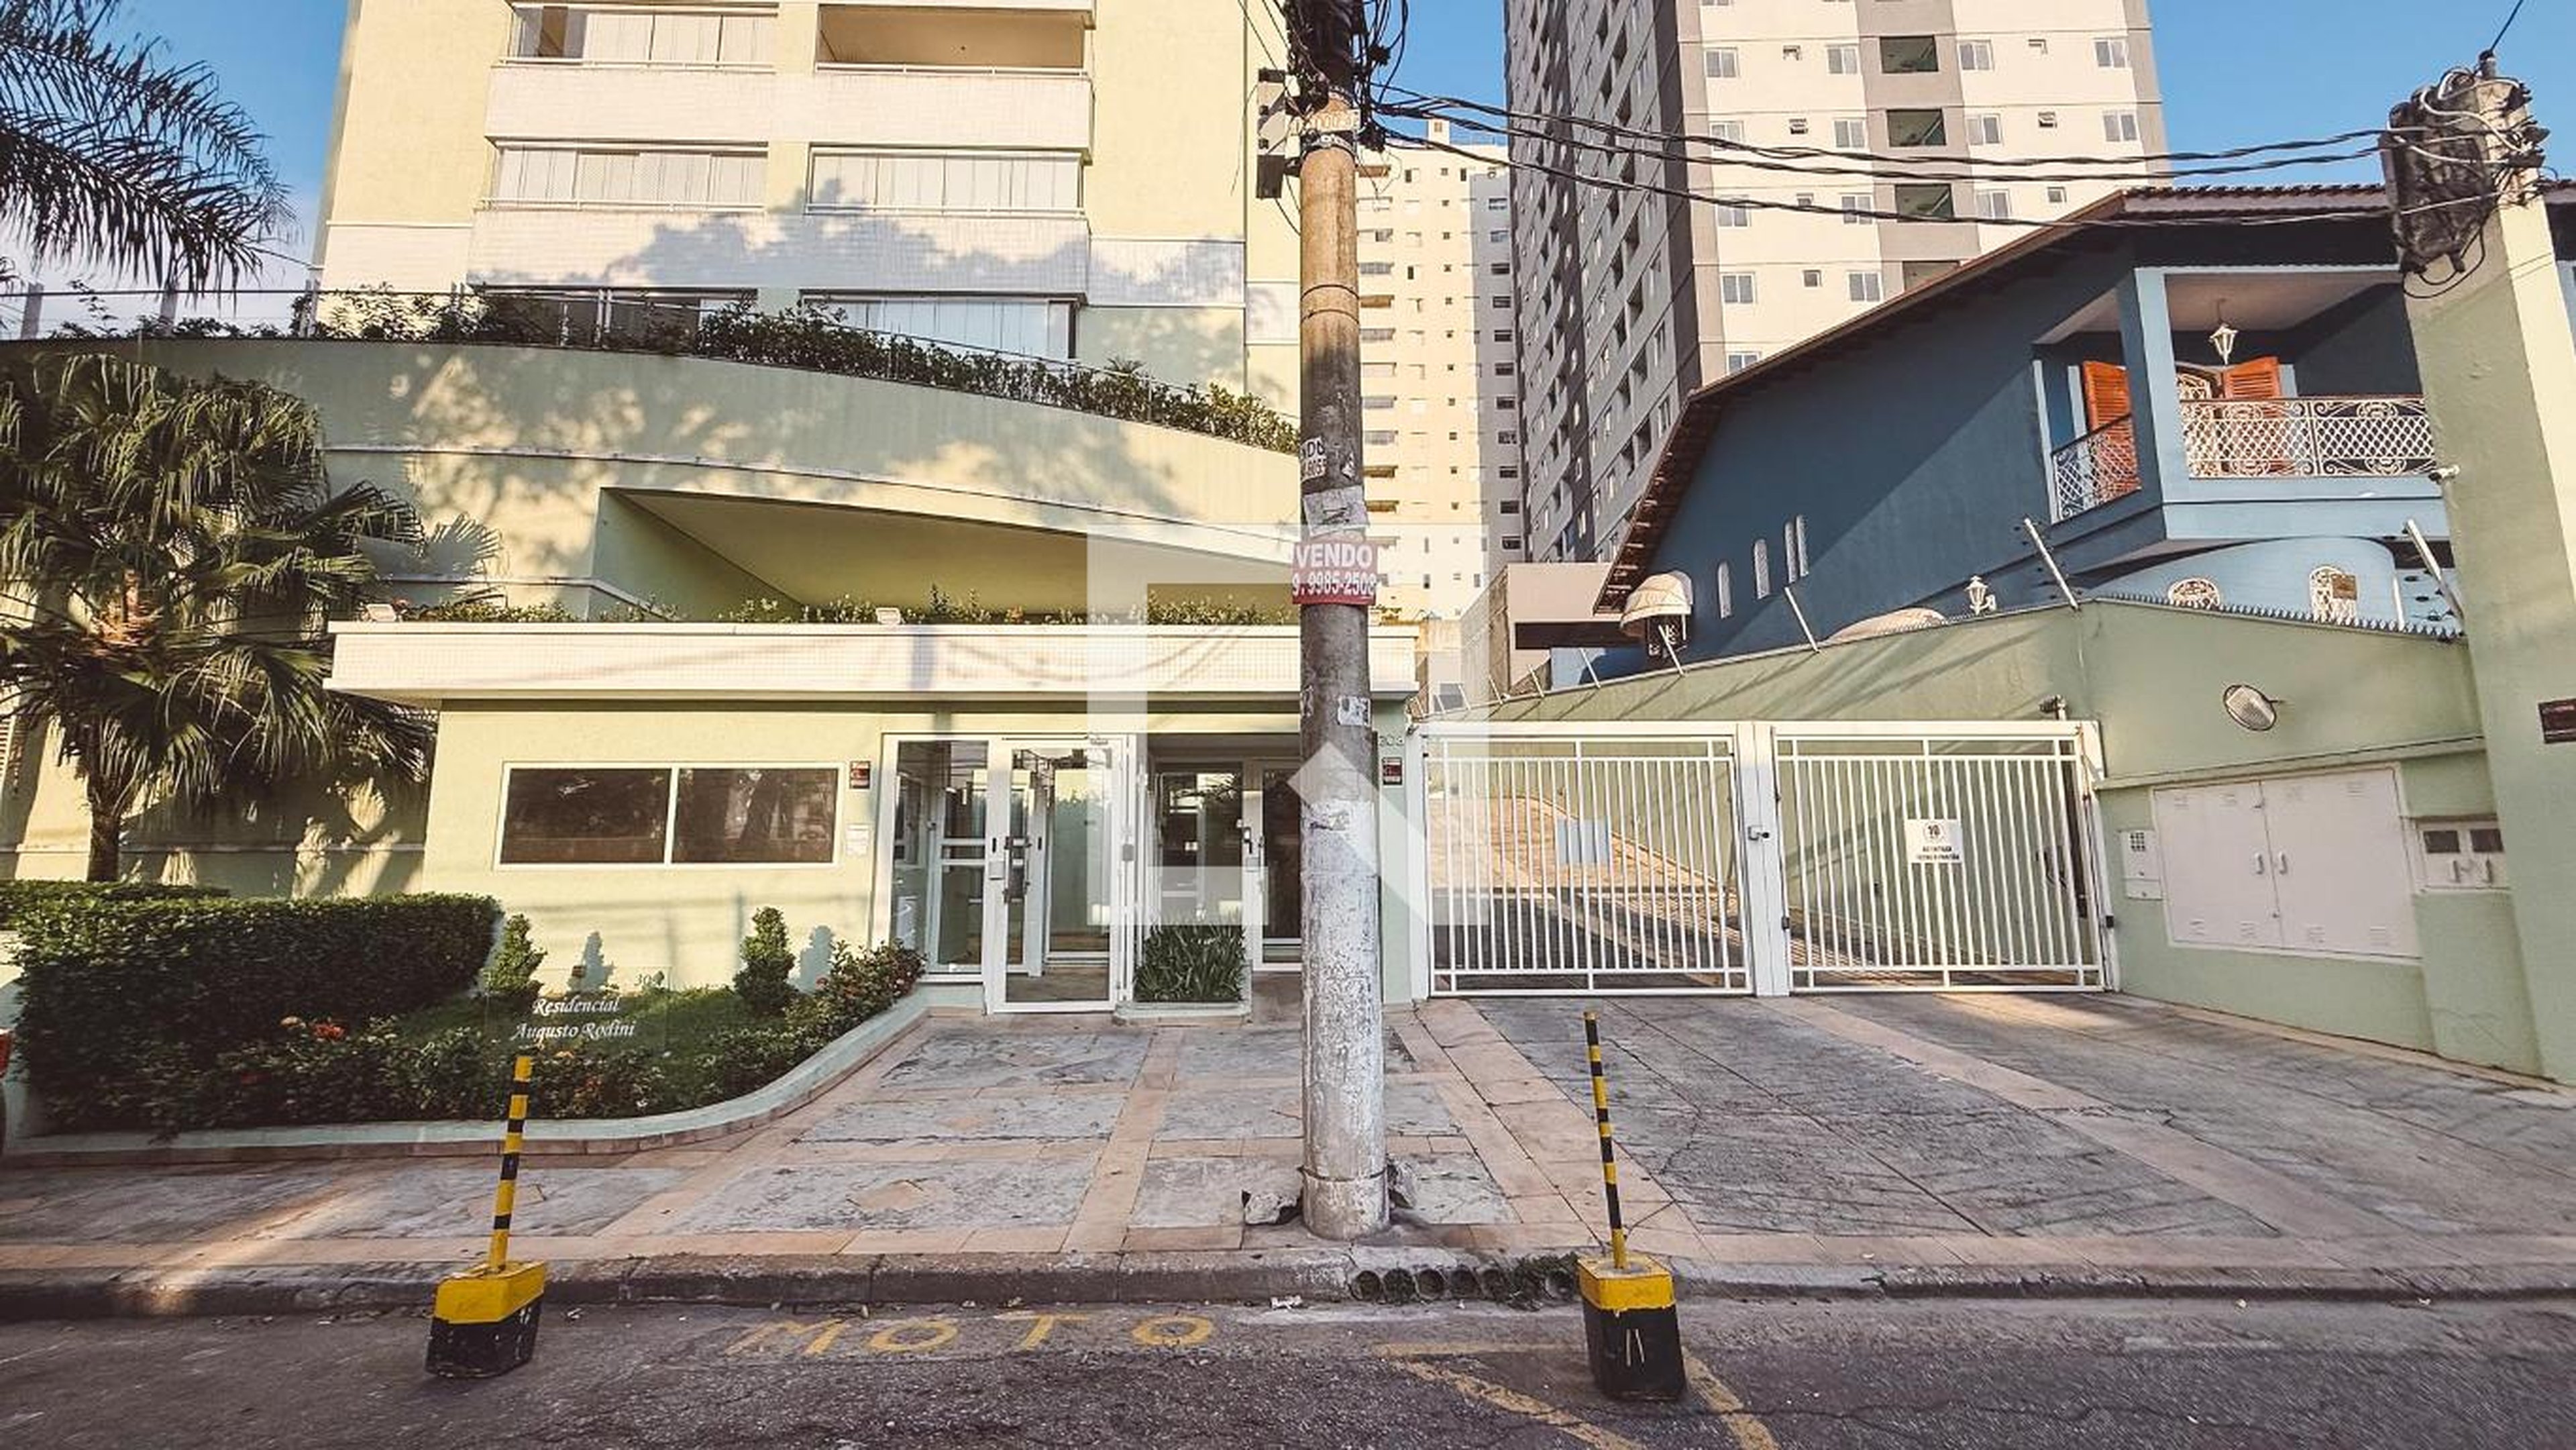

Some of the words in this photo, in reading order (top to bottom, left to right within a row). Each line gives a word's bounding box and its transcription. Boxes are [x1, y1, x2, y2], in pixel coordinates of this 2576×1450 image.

[1296, 543, 1373, 568] VENDO
[532, 994, 621, 1017] Residencial
[509, 1022, 580, 1050] Augusto
[581, 1019, 637, 1041] Rodini
[724, 1312, 1216, 1356] MOTO
